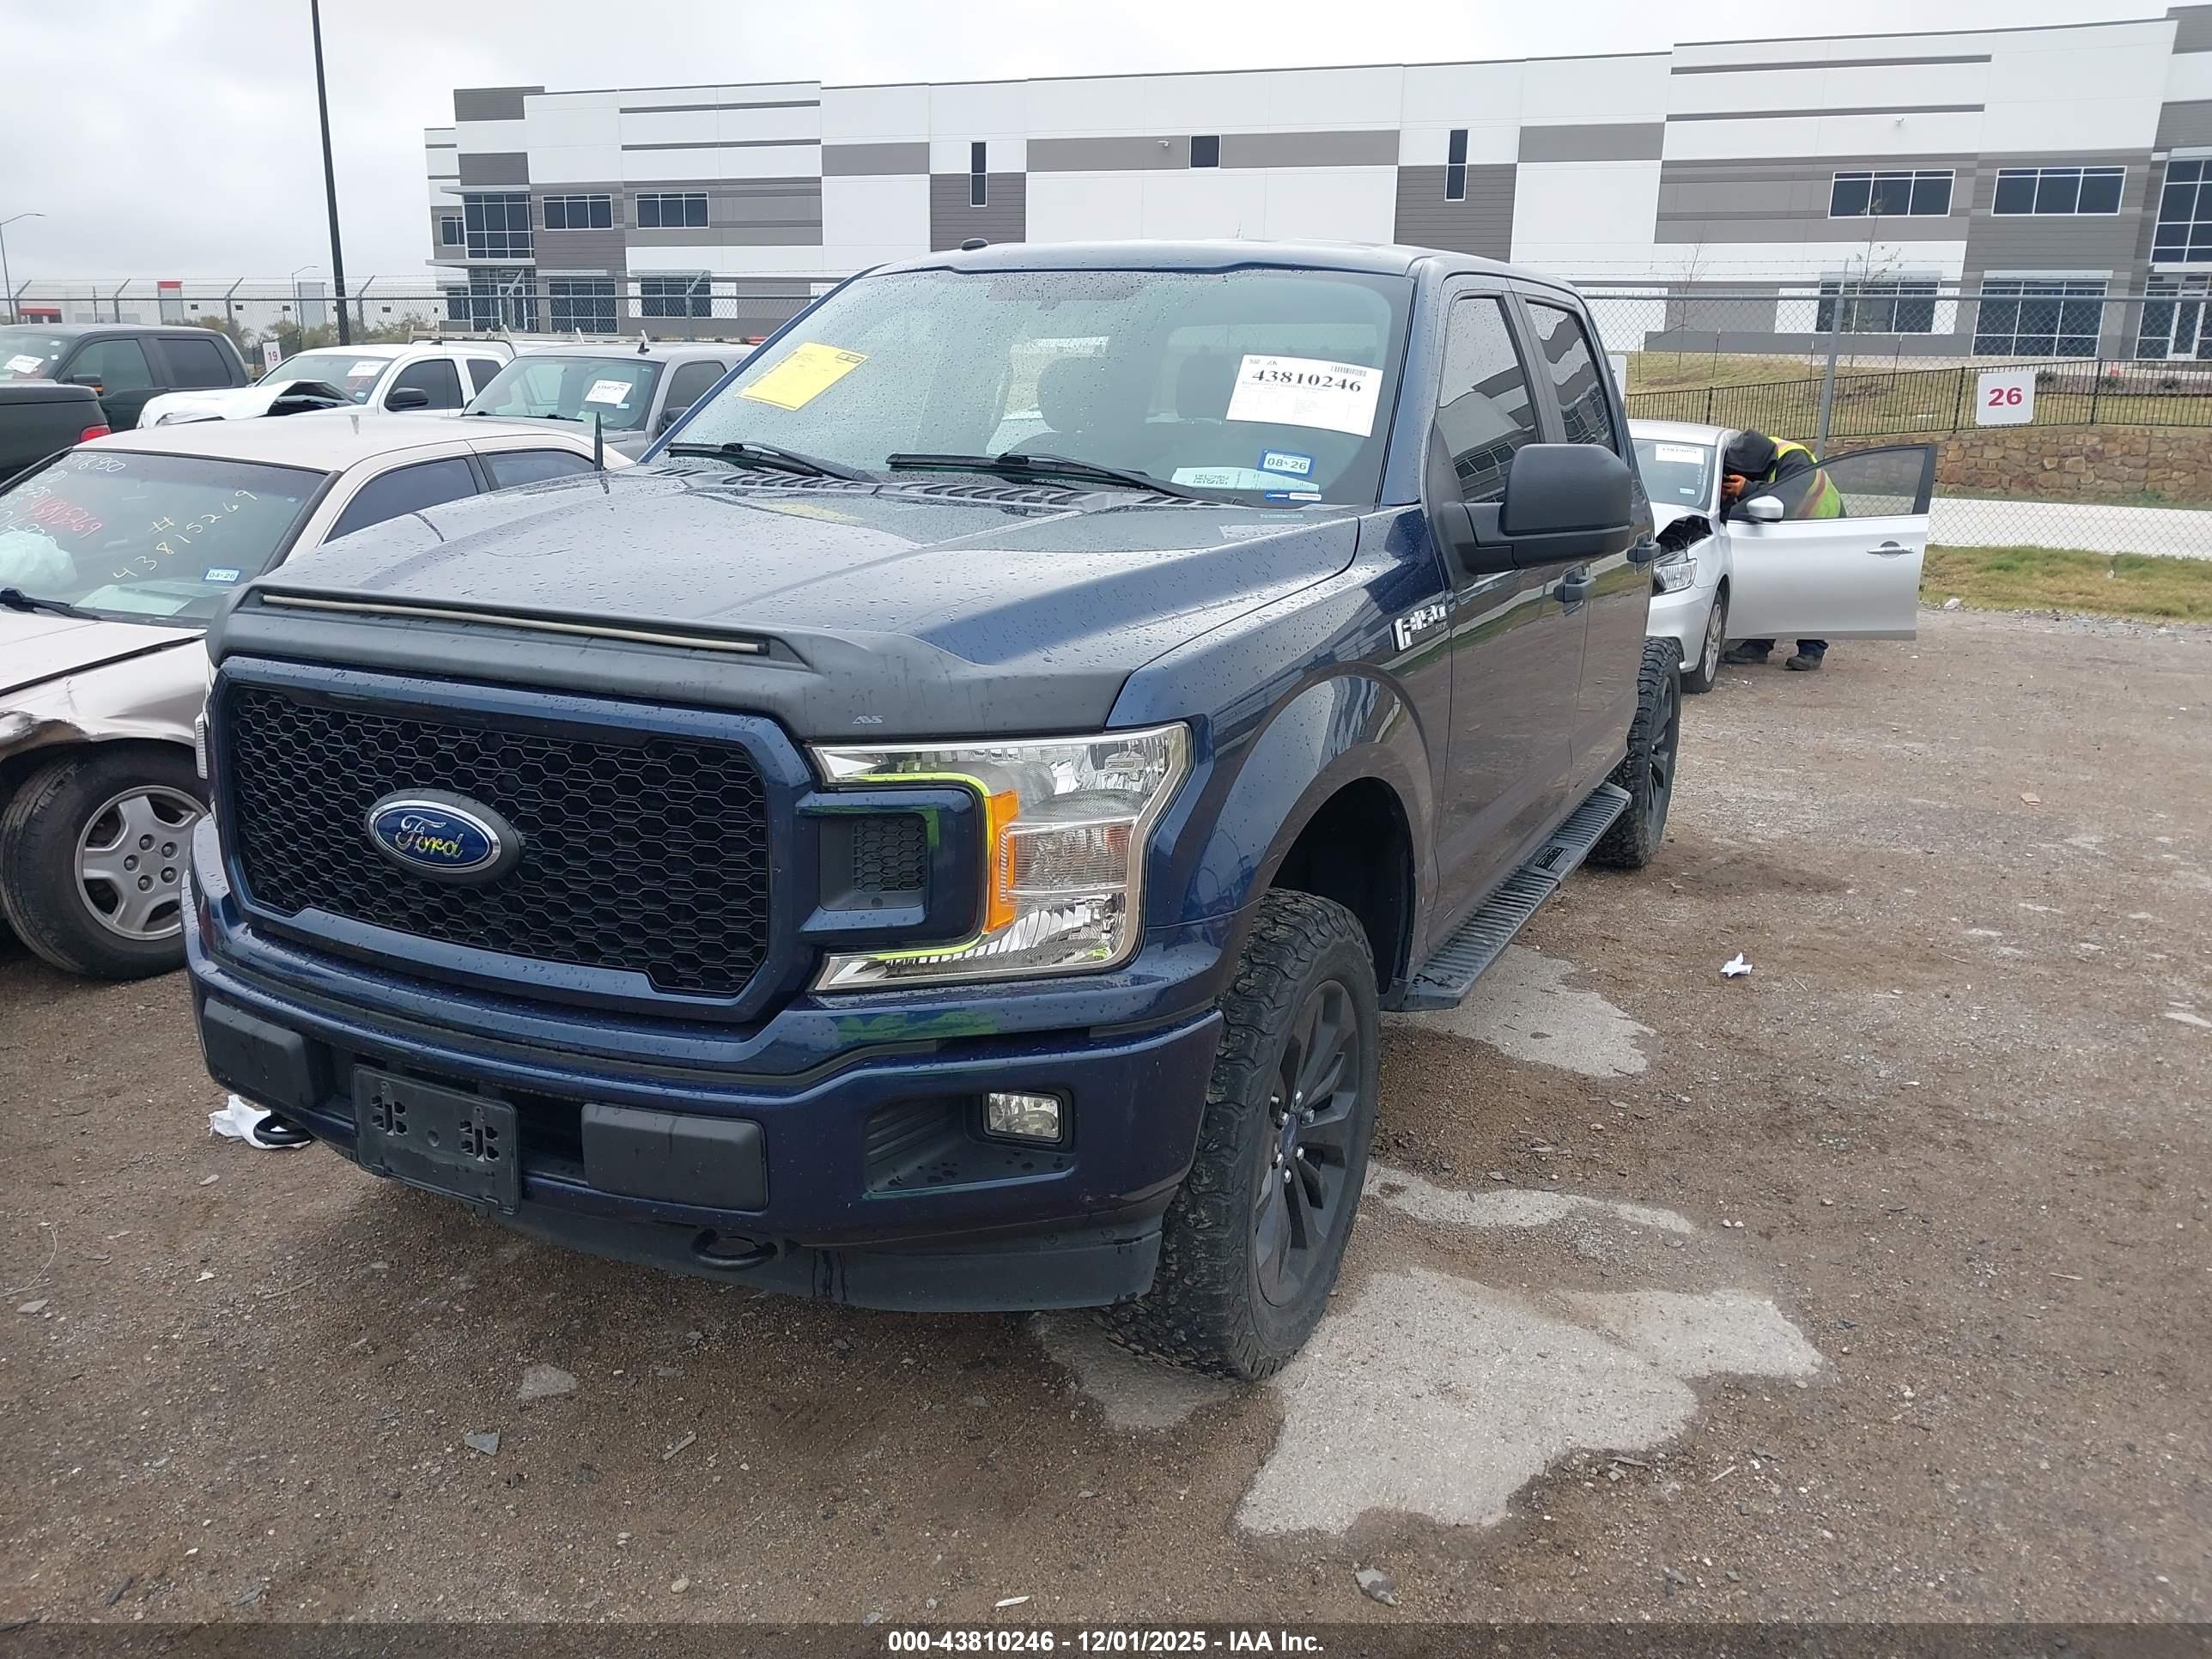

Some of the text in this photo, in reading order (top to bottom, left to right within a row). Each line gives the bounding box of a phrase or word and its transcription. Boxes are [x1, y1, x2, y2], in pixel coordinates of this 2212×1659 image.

[268, 351, 278, 362] 19
[1252, 369, 1362, 392] 43810246
[1988, 387, 2023, 407] 26
[394, 815, 465, 859] Ford
